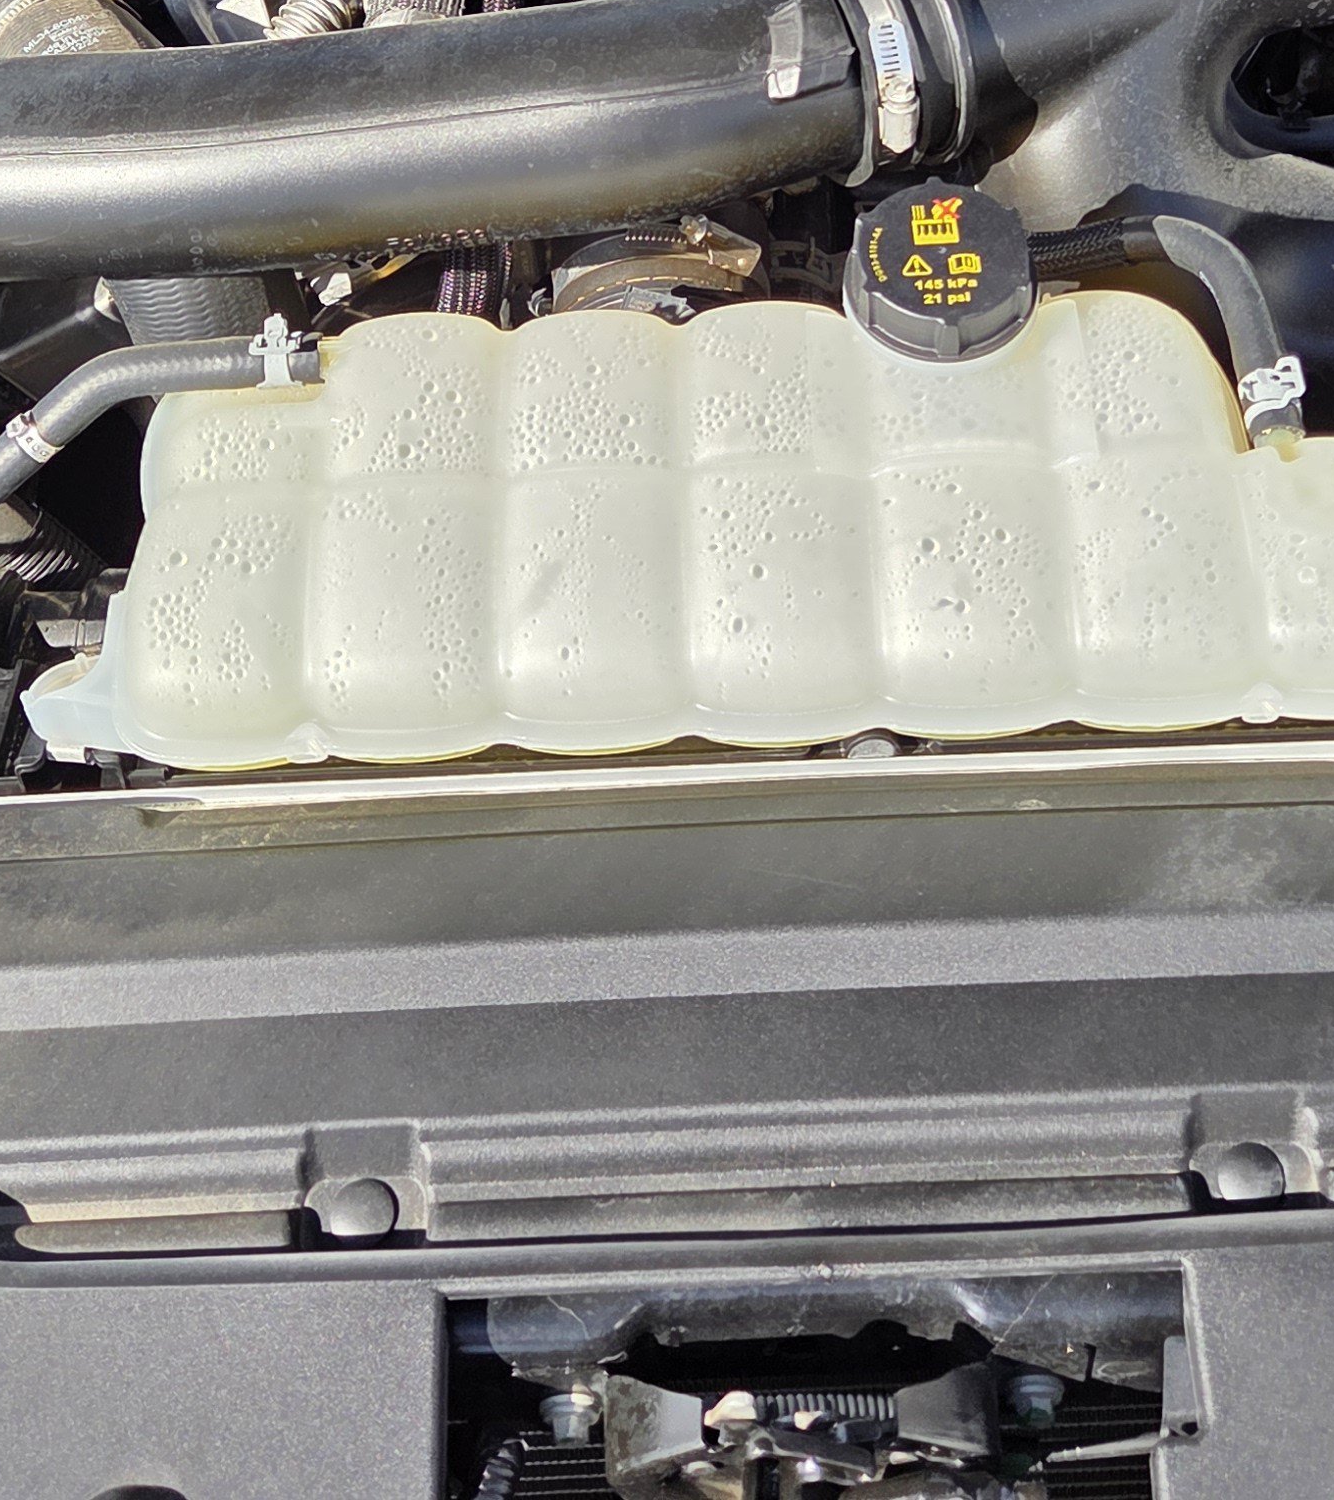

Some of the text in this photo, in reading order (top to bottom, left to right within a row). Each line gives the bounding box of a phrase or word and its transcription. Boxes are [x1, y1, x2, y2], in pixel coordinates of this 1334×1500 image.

[914, 278, 978, 291] 145 kPa
[923, 292, 971, 305] 21 psi
